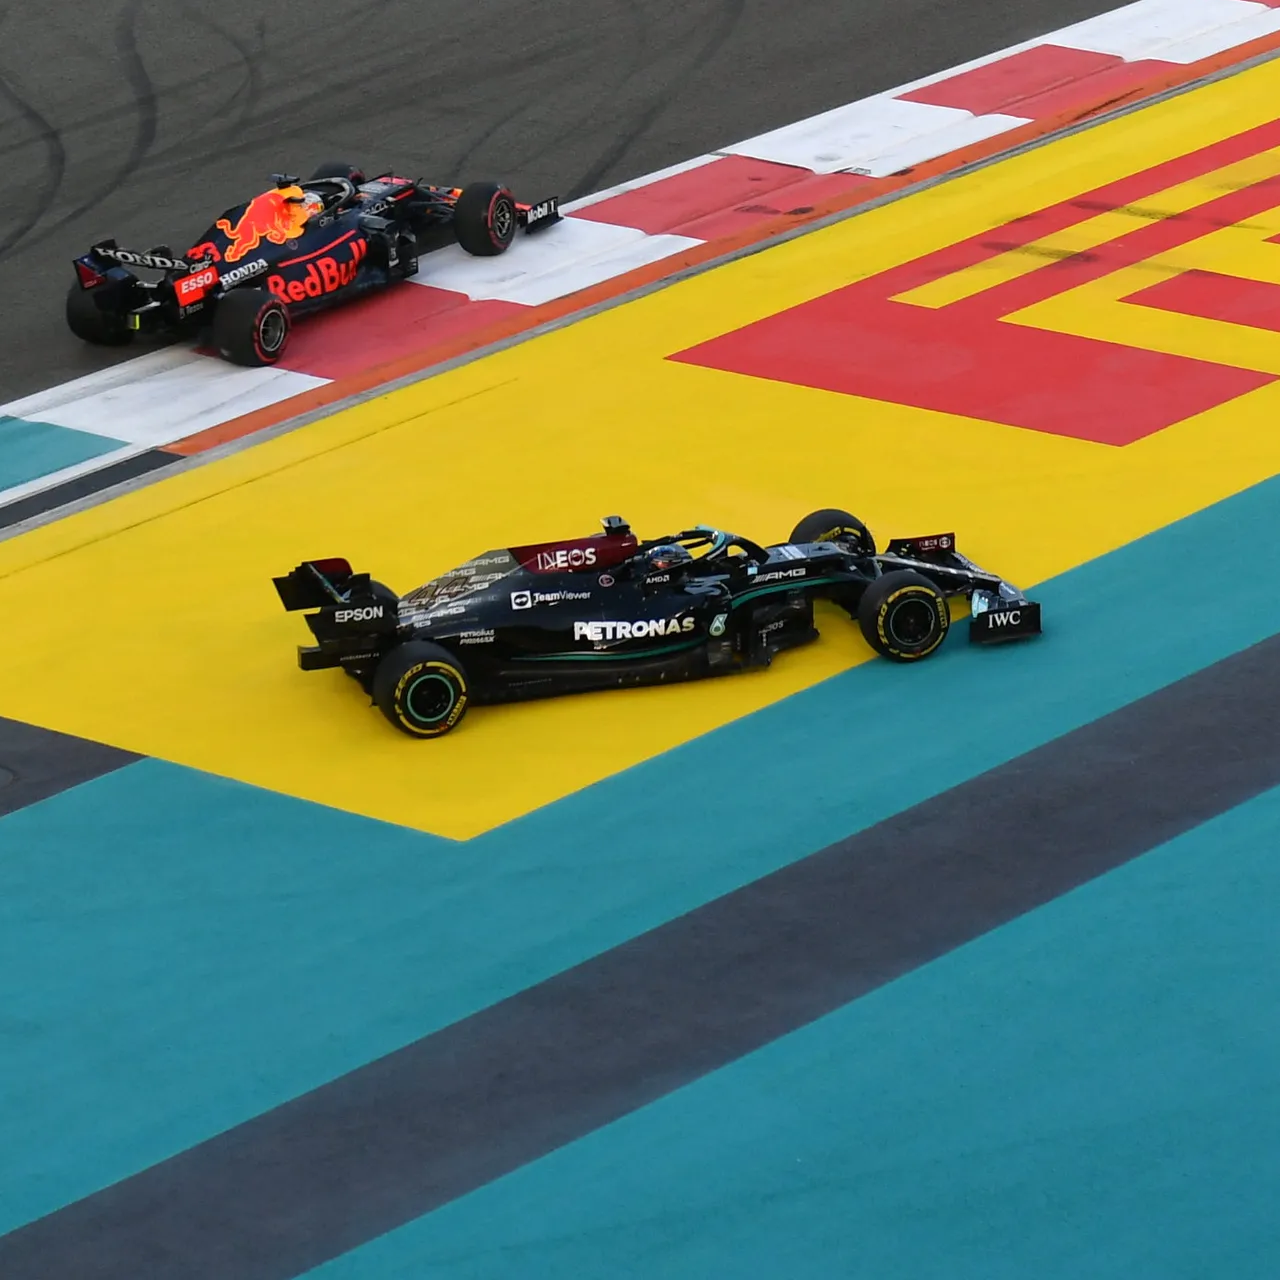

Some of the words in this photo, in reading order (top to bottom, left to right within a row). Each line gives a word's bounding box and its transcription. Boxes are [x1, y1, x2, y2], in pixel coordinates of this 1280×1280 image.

[527, 202, 548, 224] Mobil
[95, 247, 189, 270] HONDA
[181, 272, 213, 294] ESSO
[219, 258, 269, 287] HONDA
[537, 547, 597, 570] INEOS
[765, 568, 806, 582] AMG
[335, 606, 383, 622] EPSON
[988, 610, 1021, 629] IWC
[574, 617, 695, 640] PETRONAS
